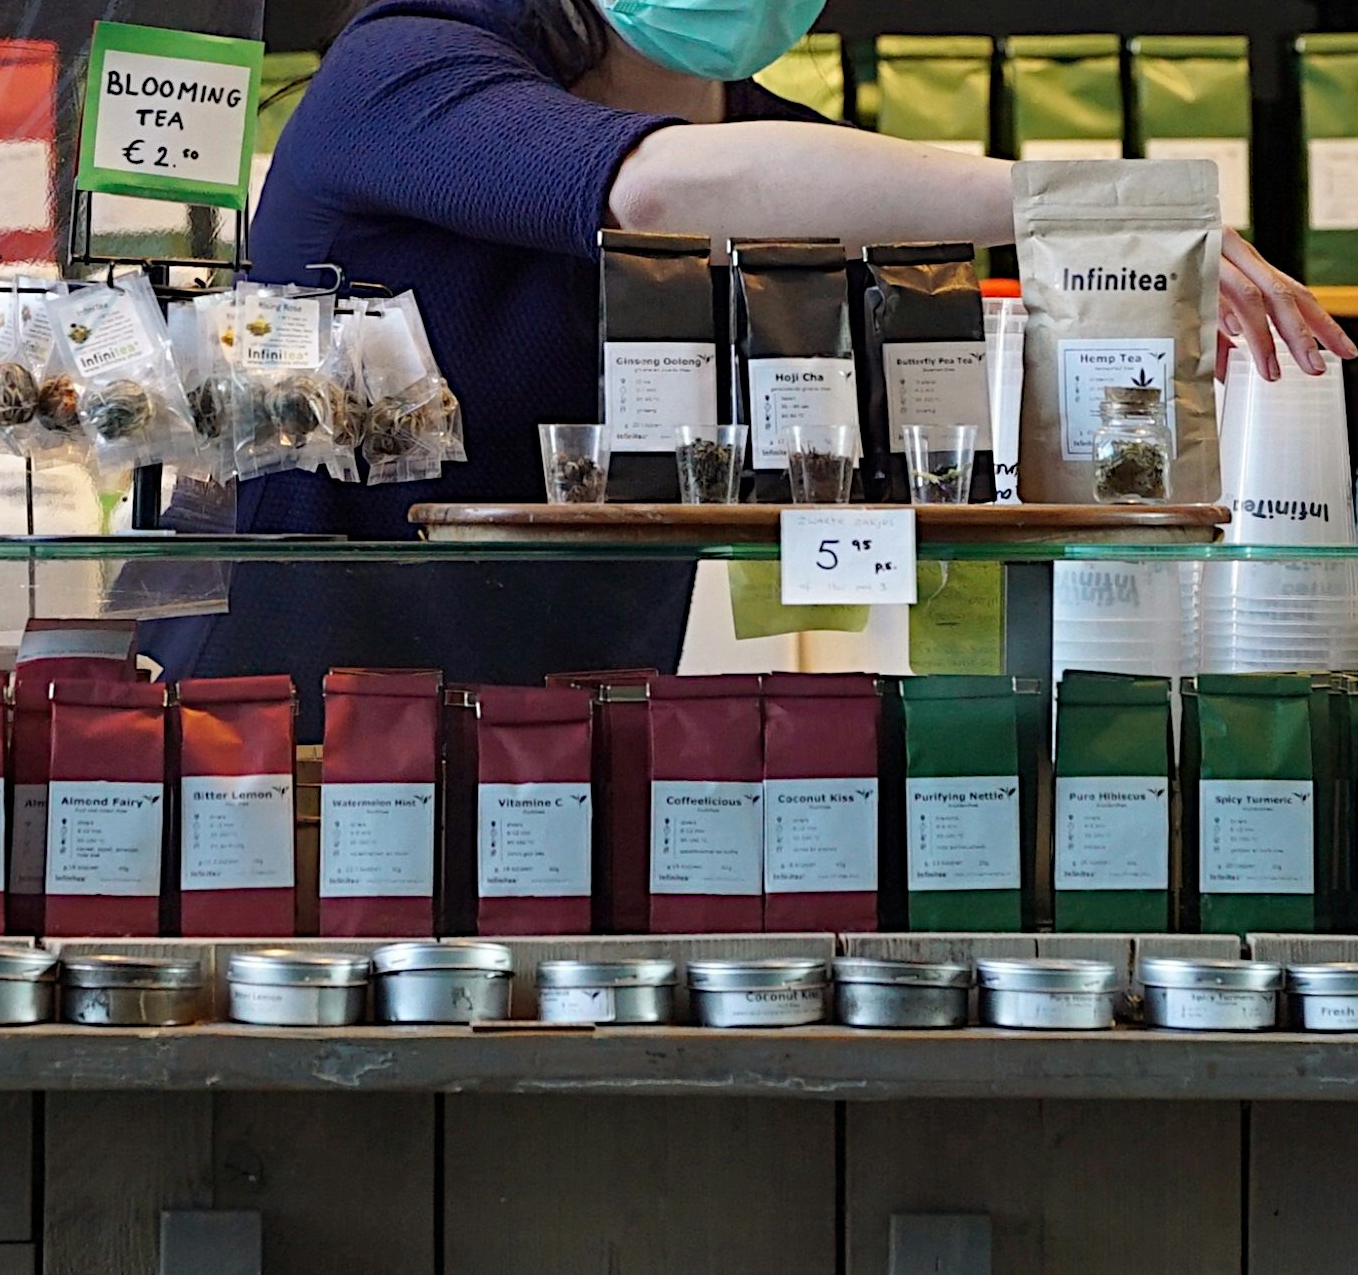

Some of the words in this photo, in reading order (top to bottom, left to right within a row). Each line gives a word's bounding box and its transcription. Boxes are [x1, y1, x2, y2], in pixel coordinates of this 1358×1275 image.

[107, 70, 242, 108] BLOOMING
[136, 109, 184, 131] TEA
[121, 139, 145, 165] €
[1063, 267, 1168, 292] Infinitea
[663, 356, 701, 367] Oolong
[896, 357, 936, 366] Butterfly
[938, 357, 954, 365] Pea
[1080, 354, 1116, 364] Hemp
[1119, 353, 1142, 363] Tea
[775, 373, 799, 384] Hoji
[803, 373, 824, 382] Cha
[816, 539, 840, 570] 5
[852, 539, 872, 551] 95
[193, 791, 227, 801] Bitter
[230, 790, 273, 800] Lemon
[778, 794, 826, 804] Coconut
[830, 793, 855, 803] Kiss
[914, 791, 966, 803] Purifying
[969, 791, 1004, 801] Nettle
[1069, 792, 1095, 802] Pure
[1098, 791, 1146, 802] Hibiscus
[1215, 795, 1241, 807] Spicy
[1245, 795, 1292, 805] Turmeric
[61, 796, 108, 806] Almond
[112, 797, 143, 808] Fairy
[332, 798, 391, 808] Watermelon
[395, 797, 416, 807] Mint
[498, 798, 551, 808] Vitamine
[555, 798, 563, 807] C
[666, 796, 742, 807] Coffeelicious
[746, 991, 798, 1003] Coconut
[1321, 1006, 1355, 1016] Fresh
